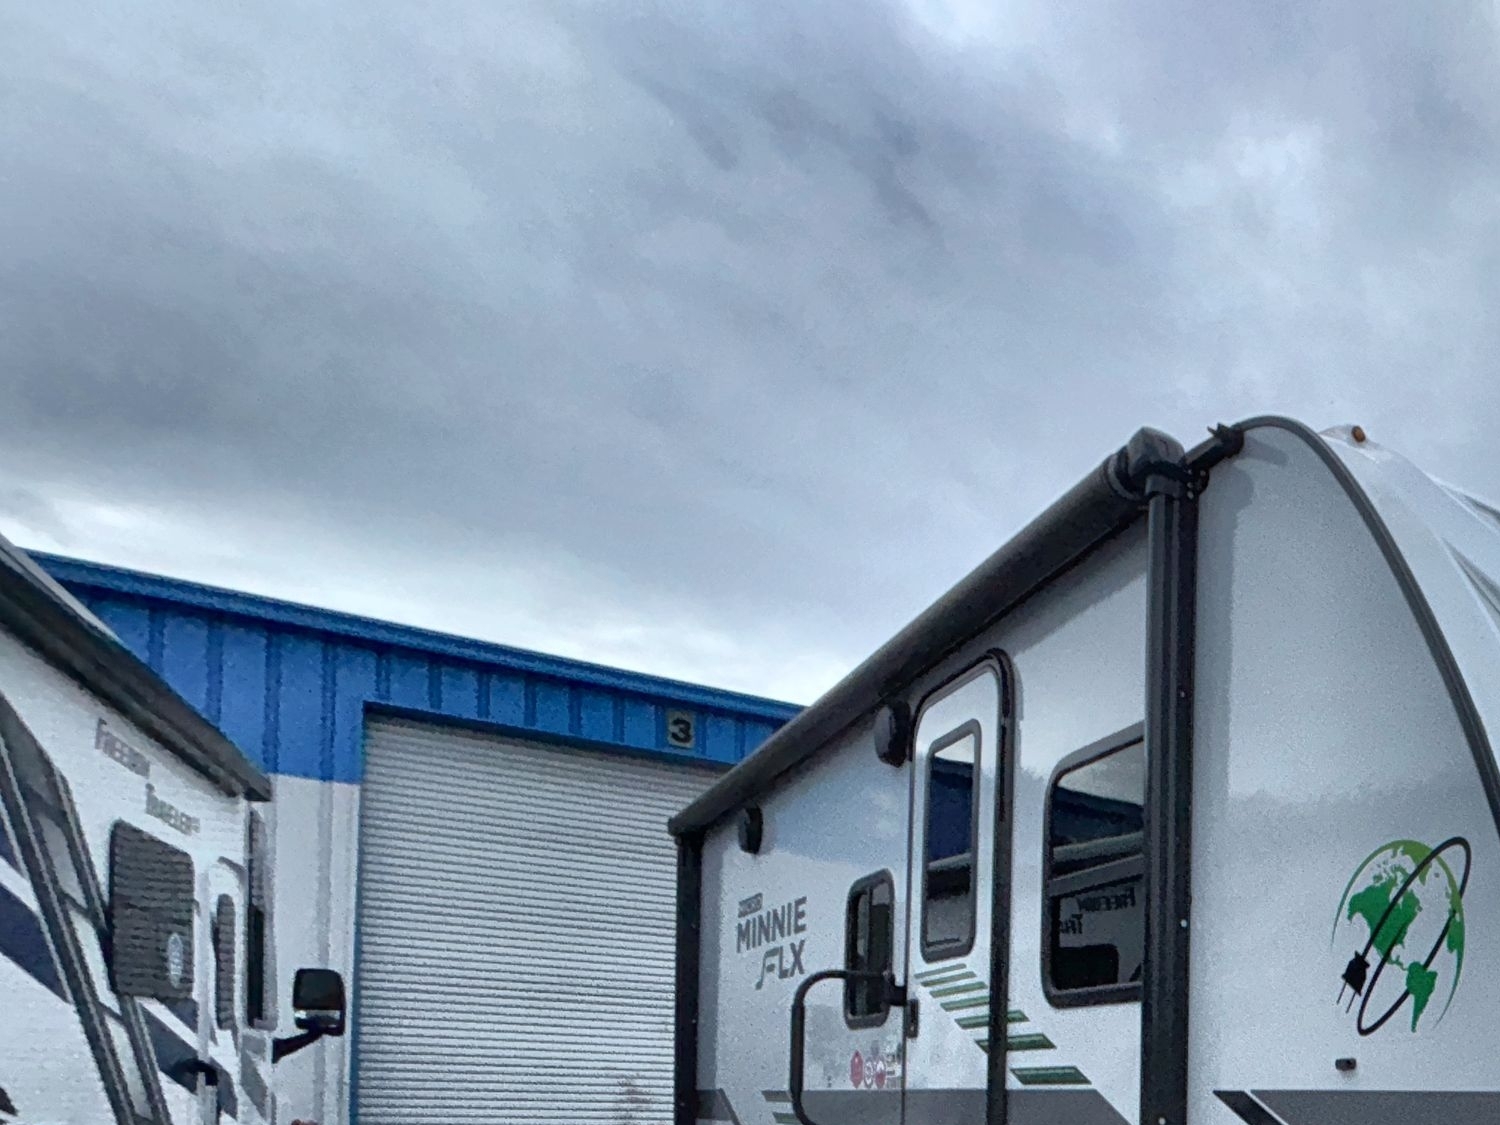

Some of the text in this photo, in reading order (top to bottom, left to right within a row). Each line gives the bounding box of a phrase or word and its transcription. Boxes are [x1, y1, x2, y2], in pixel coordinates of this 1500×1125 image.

[671, 718, 692, 744] 3
[736, 896, 808, 953] MINNIE
[755, 939, 807, 990] FLX
